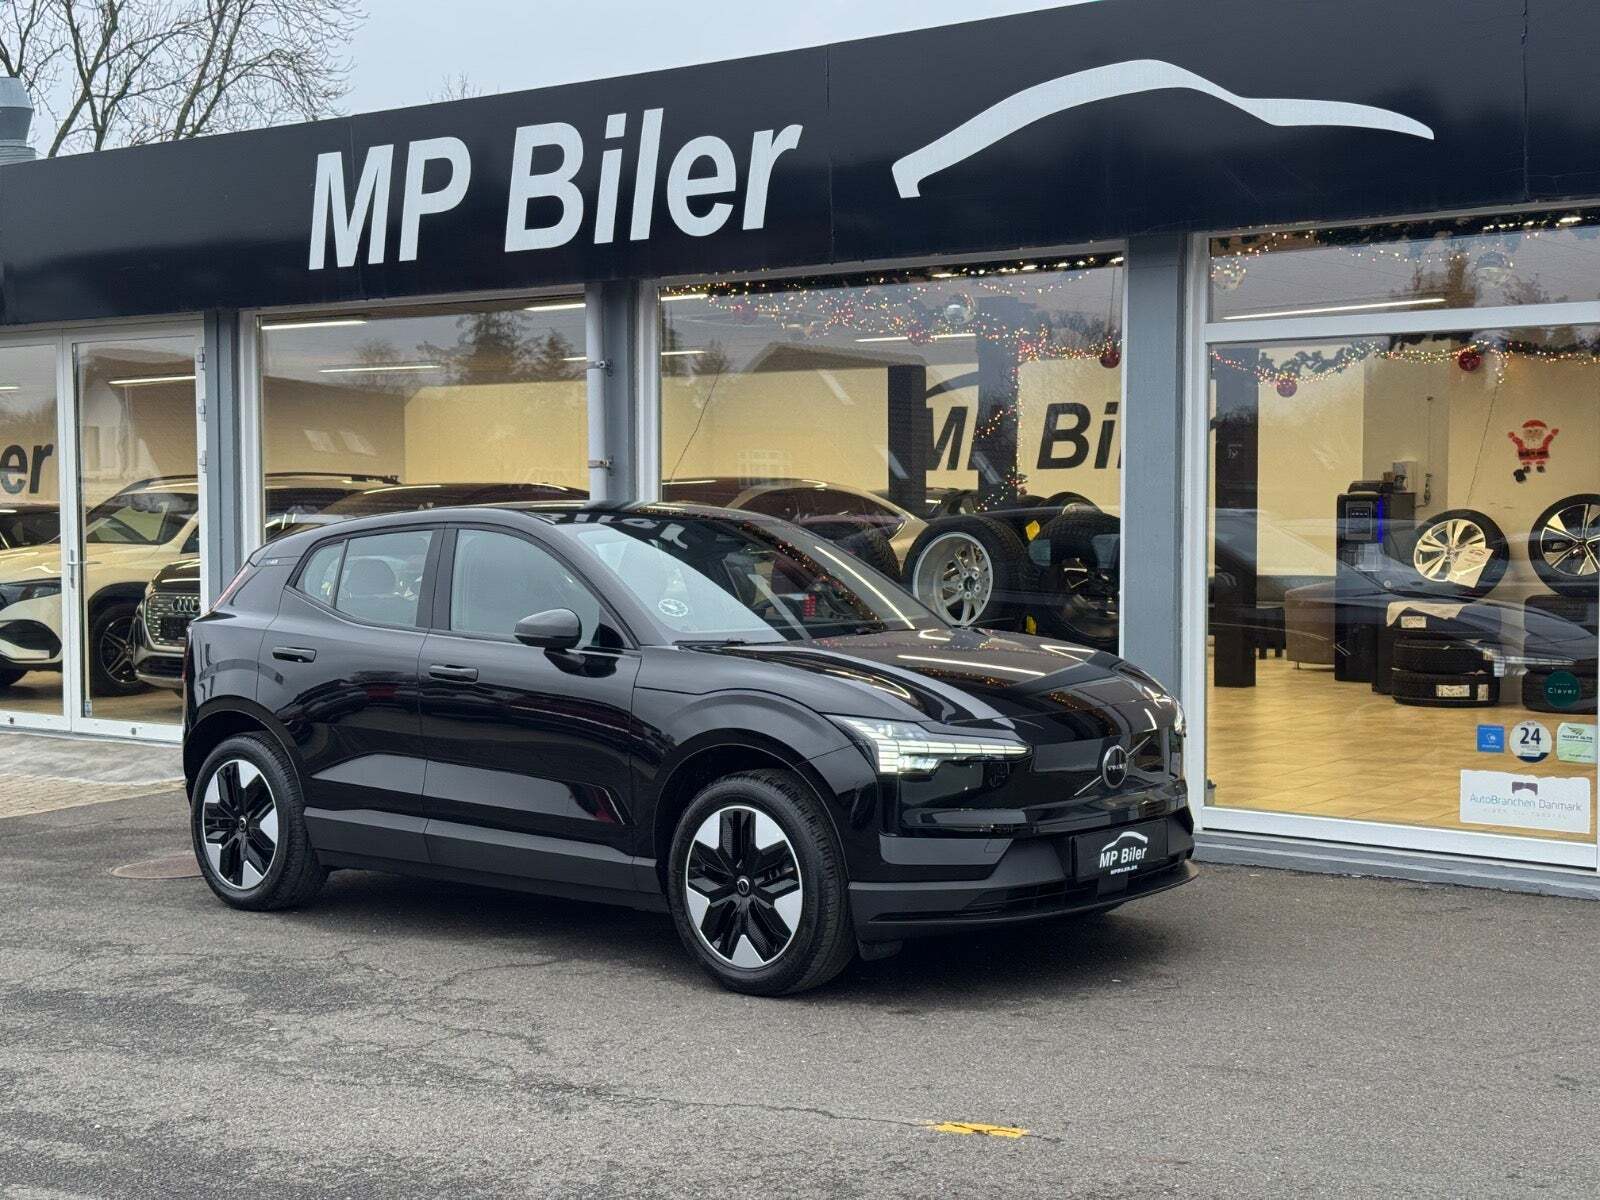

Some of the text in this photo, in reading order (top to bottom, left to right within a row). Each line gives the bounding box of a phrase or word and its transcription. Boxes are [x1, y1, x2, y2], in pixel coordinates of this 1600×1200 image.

[308, 107, 804, 271] MP Biler
[1037, 402, 1121, 469] Bi
[1547, 687, 1577, 695] Clever
[1520, 727, 1540, 745] 24
[1471, 793, 1582, 812] AutoBranchen Danmark
[1099, 846, 1147, 868] MP Biler
